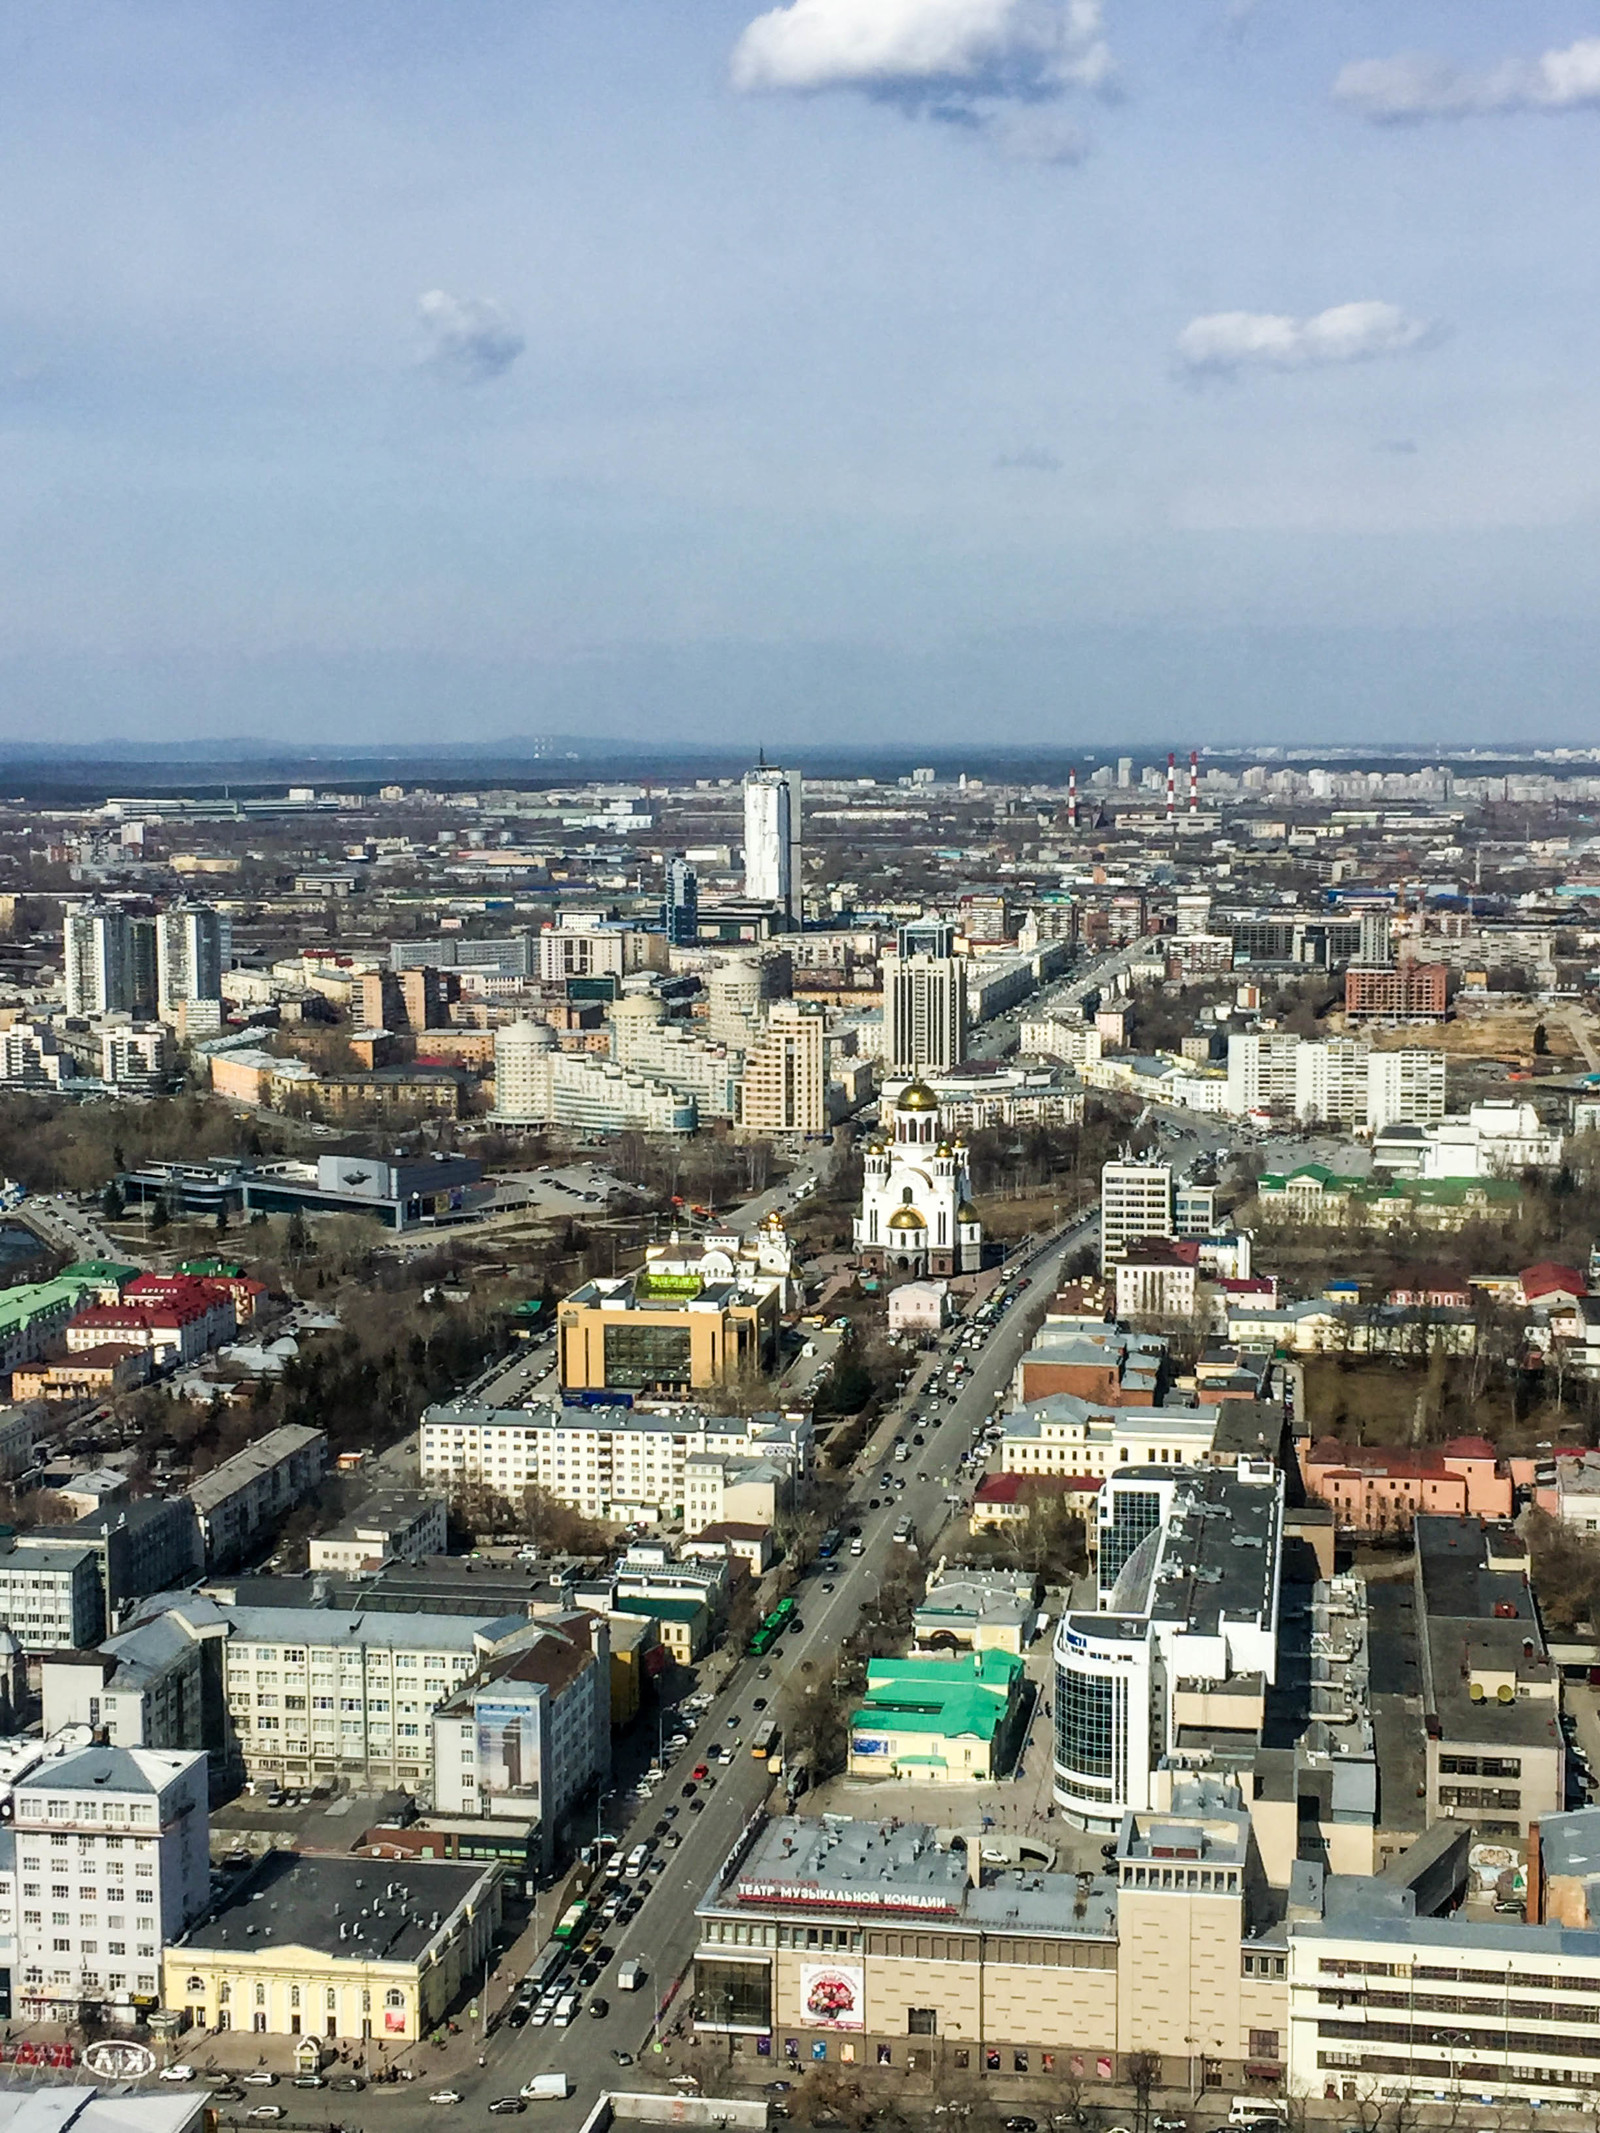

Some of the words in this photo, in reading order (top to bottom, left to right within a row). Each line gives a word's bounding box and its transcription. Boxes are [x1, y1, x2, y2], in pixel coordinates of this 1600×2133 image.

[738, 1883, 775, 1897] ТЕАТР
[780, 1886, 879, 1904] МУЗЫКАЛЬНОЙ
[884, 1893, 946, 1909] КОМЕДИИ
